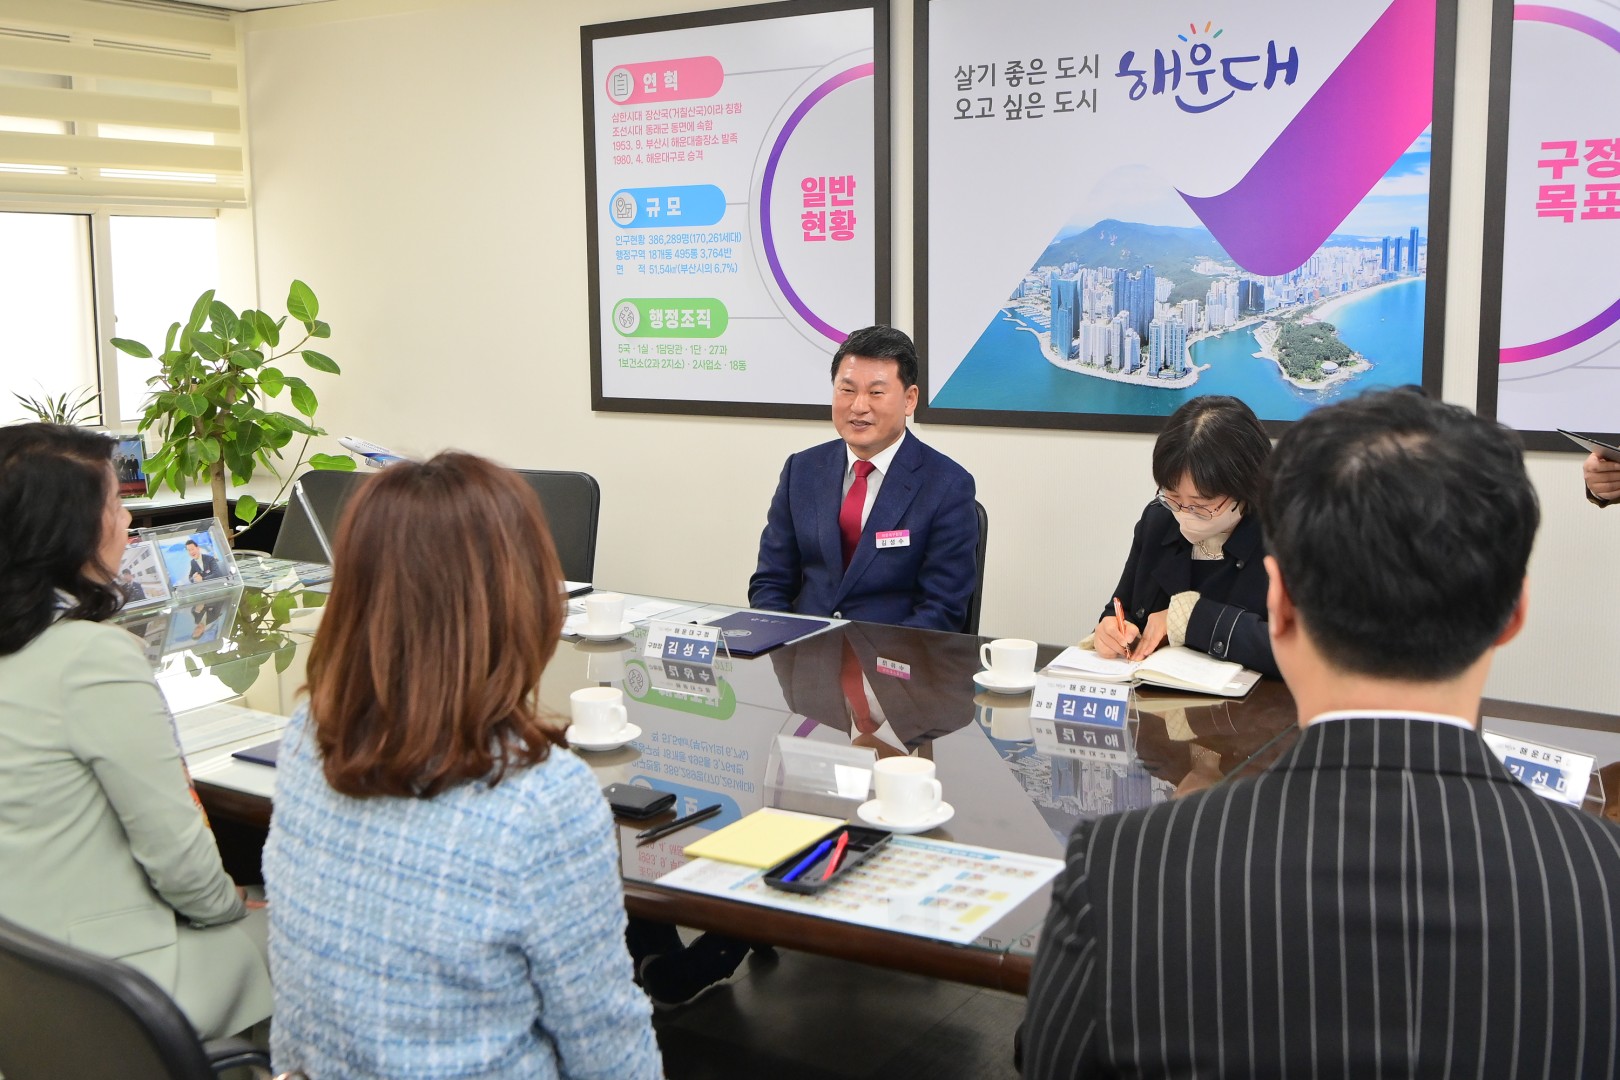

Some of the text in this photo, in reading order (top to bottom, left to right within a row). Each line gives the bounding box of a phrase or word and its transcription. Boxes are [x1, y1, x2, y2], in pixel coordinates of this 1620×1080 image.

[954, 53, 1100, 91] 살기 좋은 도시
[1115, 40, 1299, 114] 해운대
[612, 111, 643, 123] 삼한시대
[725, 102, 743, 115] 칭함
[954, 88, 1098, 121] 오고 싶은 도시
[612, 119, 713, 137] 조선시대 동래군 동면에 속함
[612, 132, 738, 151] 1953. 9. 부산시 해운대출장소 발족
[613, 149, 704, 165] 1980. 4. 해운대구로 승격
[1537, 137, 1620, 180] 구정
[801, 175, 857, 208] 일반
[1535, 183, 1620, 223] 목표
[801, 209, 857, 242] 현황
[615, 234, 646, 246] 인구현황
[615, 247, 732, 260] 행정구역 18개동 495통 3,764반
[648, 308, 711, 329] 행정조직
[618, 343, 728, 356] 5국 1실 1담당관 1단 27과
[692, 359, 722, 371] 2사업소
[729, 360, 747, 371] 18동
[667, 641, 710, 659] 김성수
[1062, 699, 1119, 722] 김신애
